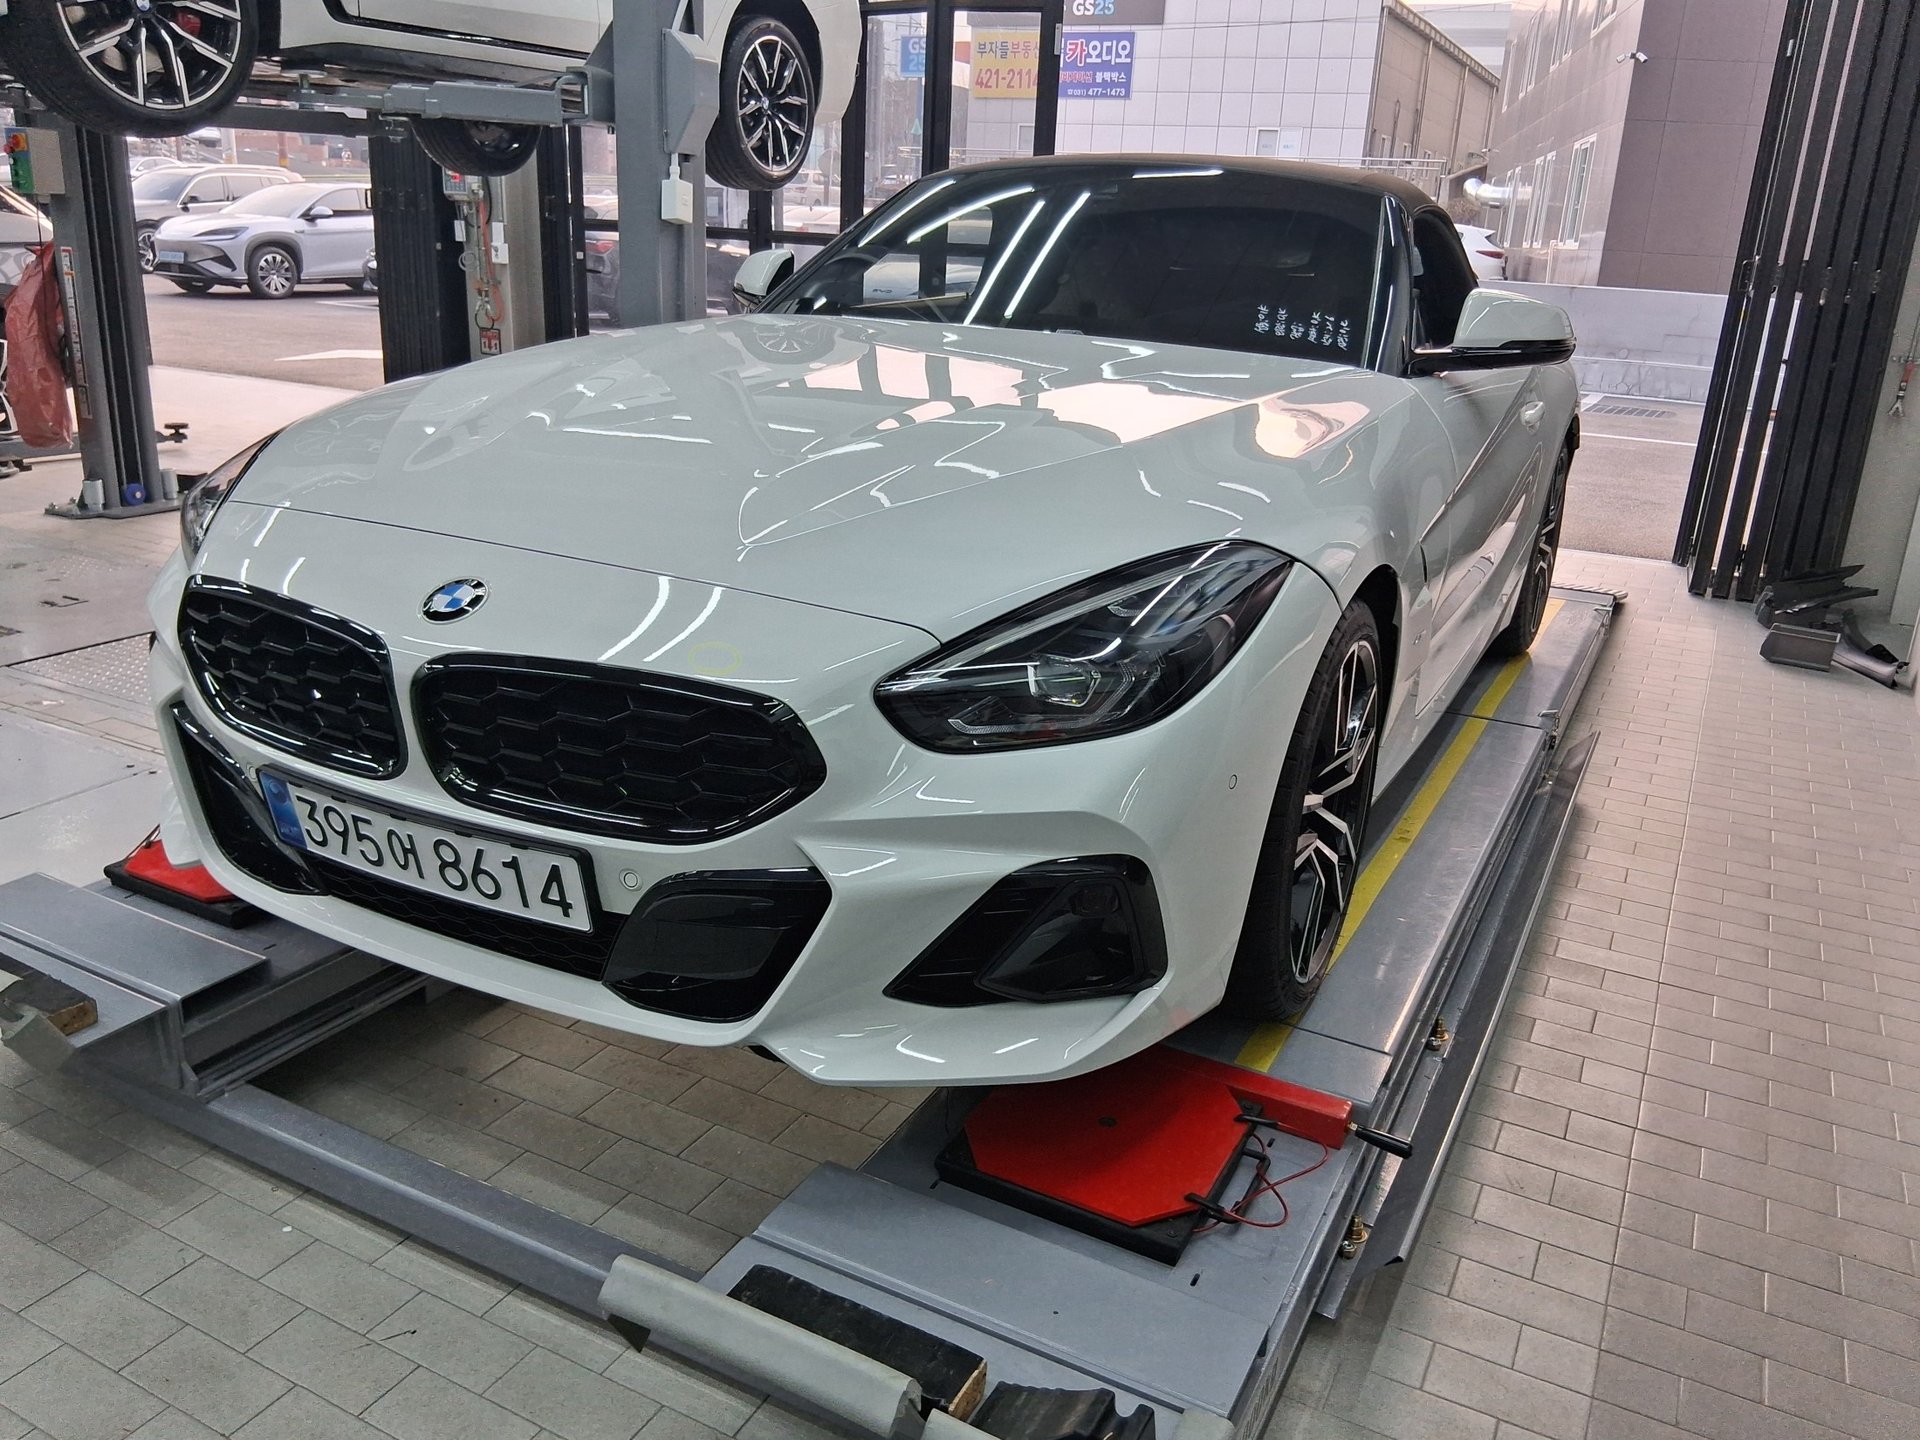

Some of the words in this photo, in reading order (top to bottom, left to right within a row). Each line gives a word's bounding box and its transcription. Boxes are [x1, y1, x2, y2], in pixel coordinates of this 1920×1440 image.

[1072, 0, 1114, 16] GS25
[908, 38, 926, 54] GS
[1060, 38, 1131, 67] 카오디오
[1088, 88, 1125, 97] 477-1473
[295, 794, 425, 880] 395어
[433, 837, 573, 919] 8614
